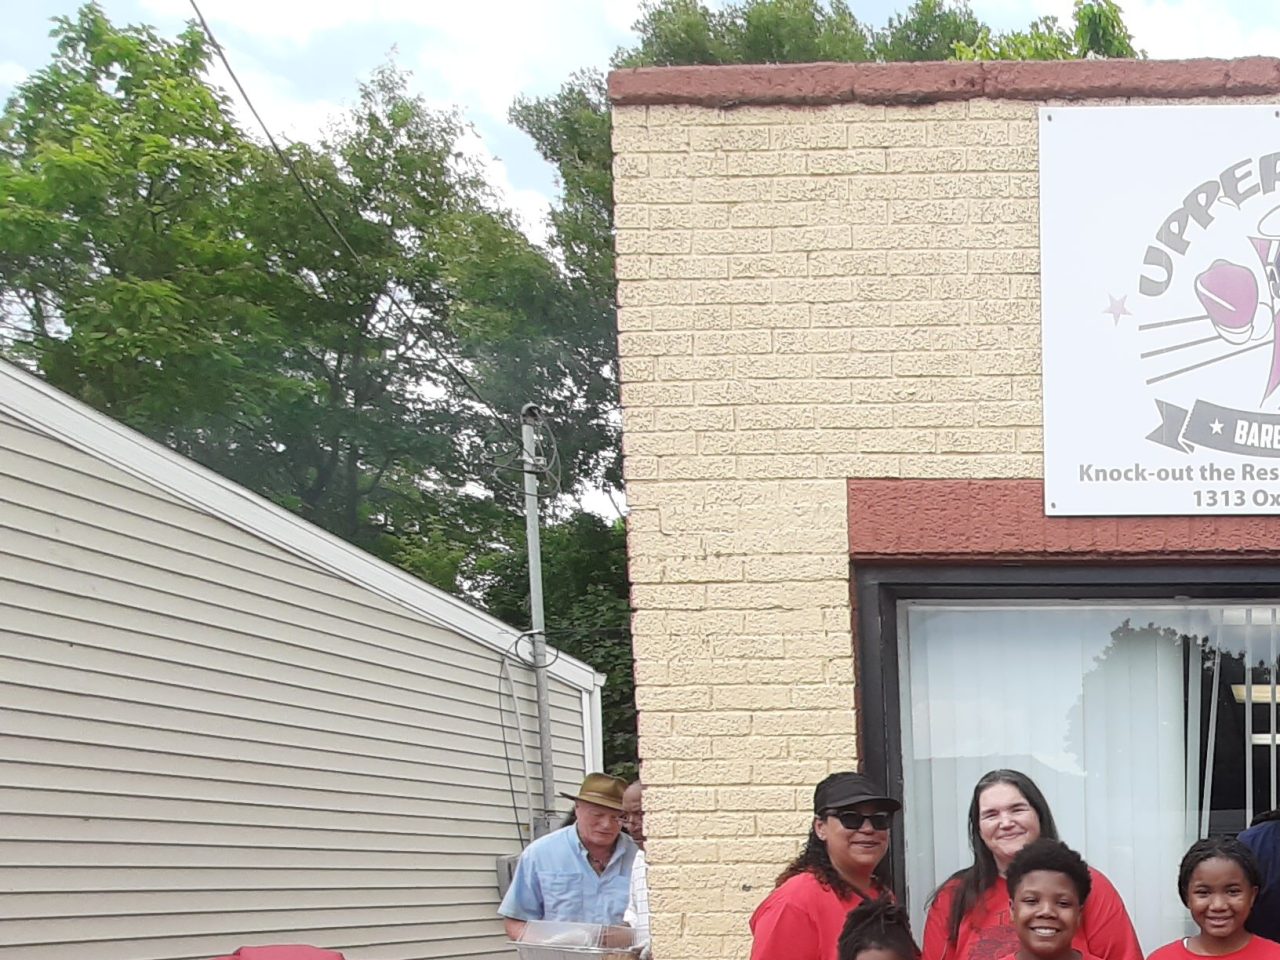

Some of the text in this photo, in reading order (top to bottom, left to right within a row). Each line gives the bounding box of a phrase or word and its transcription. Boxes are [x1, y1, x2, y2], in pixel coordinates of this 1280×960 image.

[1079, 463, 1194, 482] Knock-out
[1200, 463, 1236, 481] the
[1193, 490, 1246, 507] 1313
